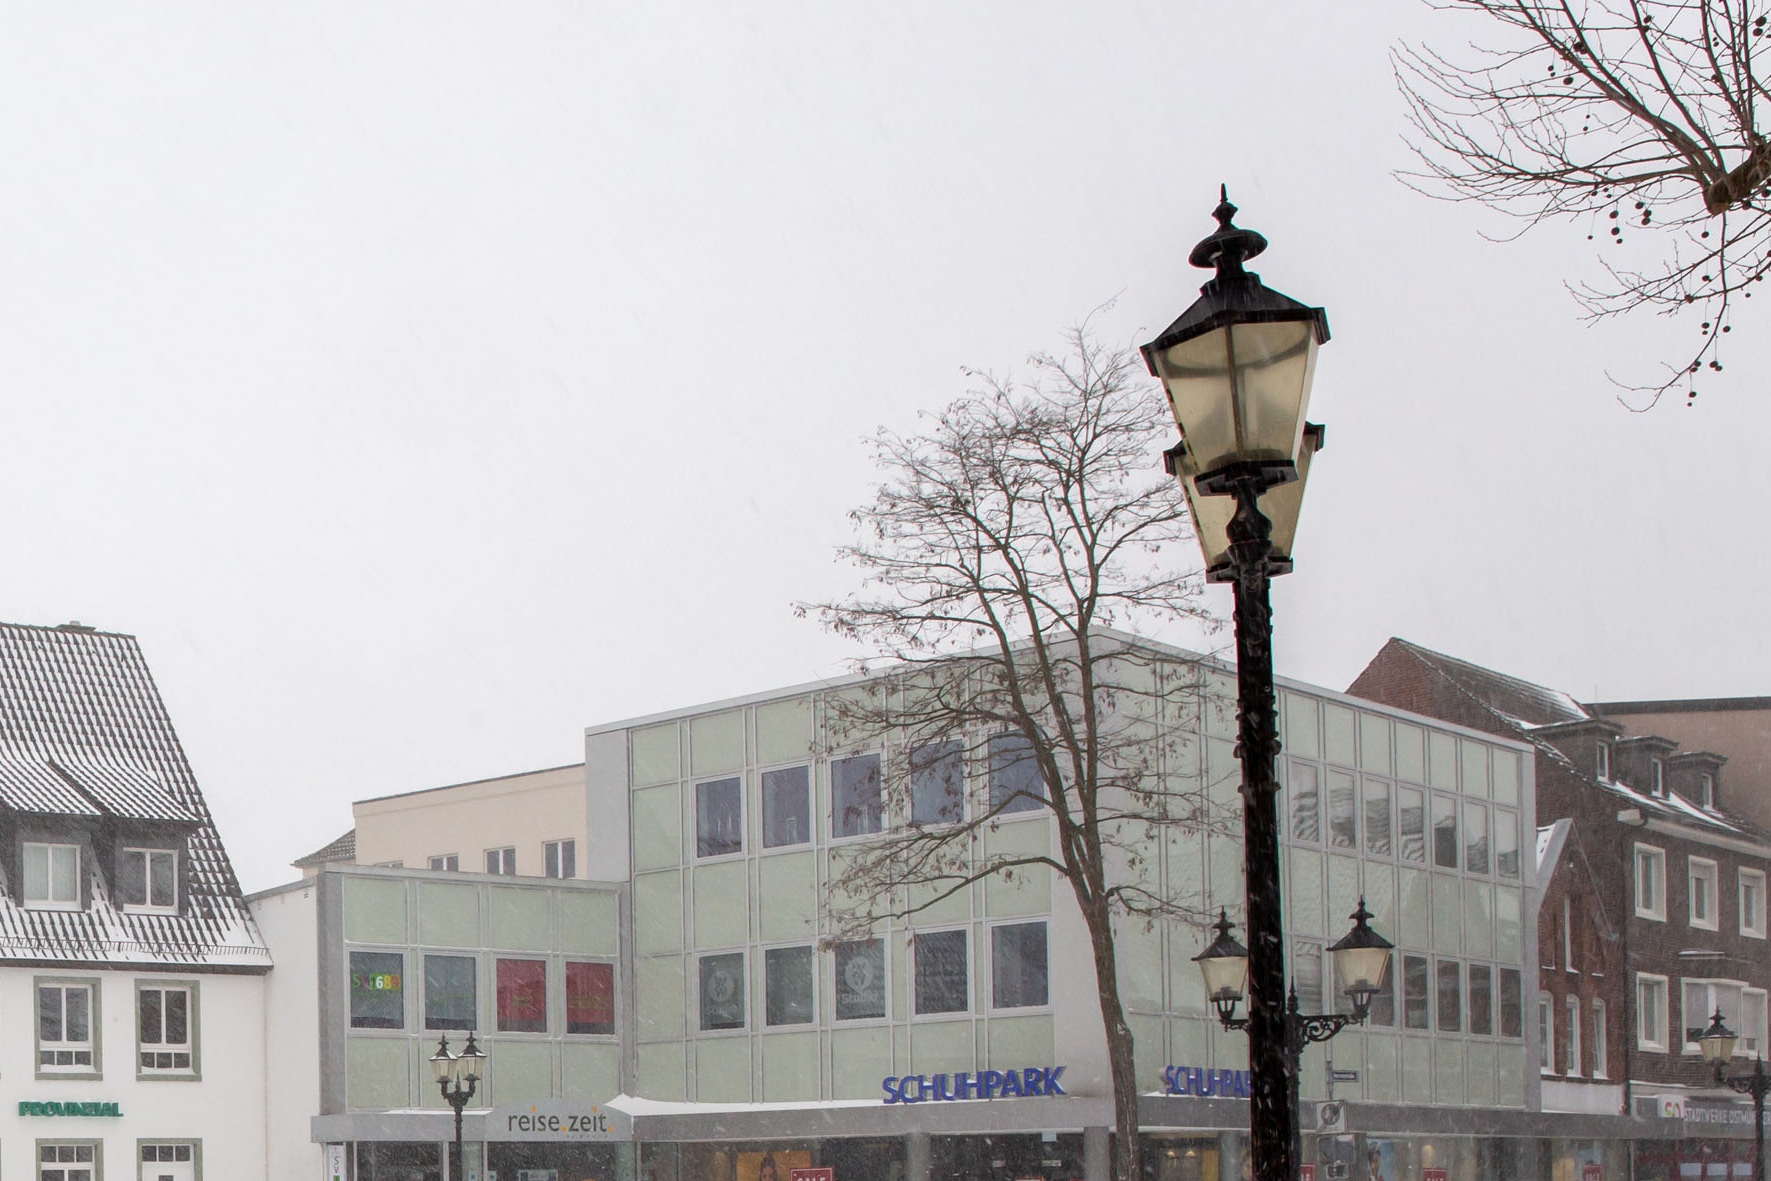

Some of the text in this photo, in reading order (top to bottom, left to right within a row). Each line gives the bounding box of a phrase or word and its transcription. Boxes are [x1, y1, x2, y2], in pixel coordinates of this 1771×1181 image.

[882, 1066, 1067, 1104] SCHUHPARK
[1165, 1065, 1250, 1099] SCHUHPA
[19, 1101, 124, 1117] PROVINZIAL
[1684, 1107, 1728, 1124] STADTWERKE
